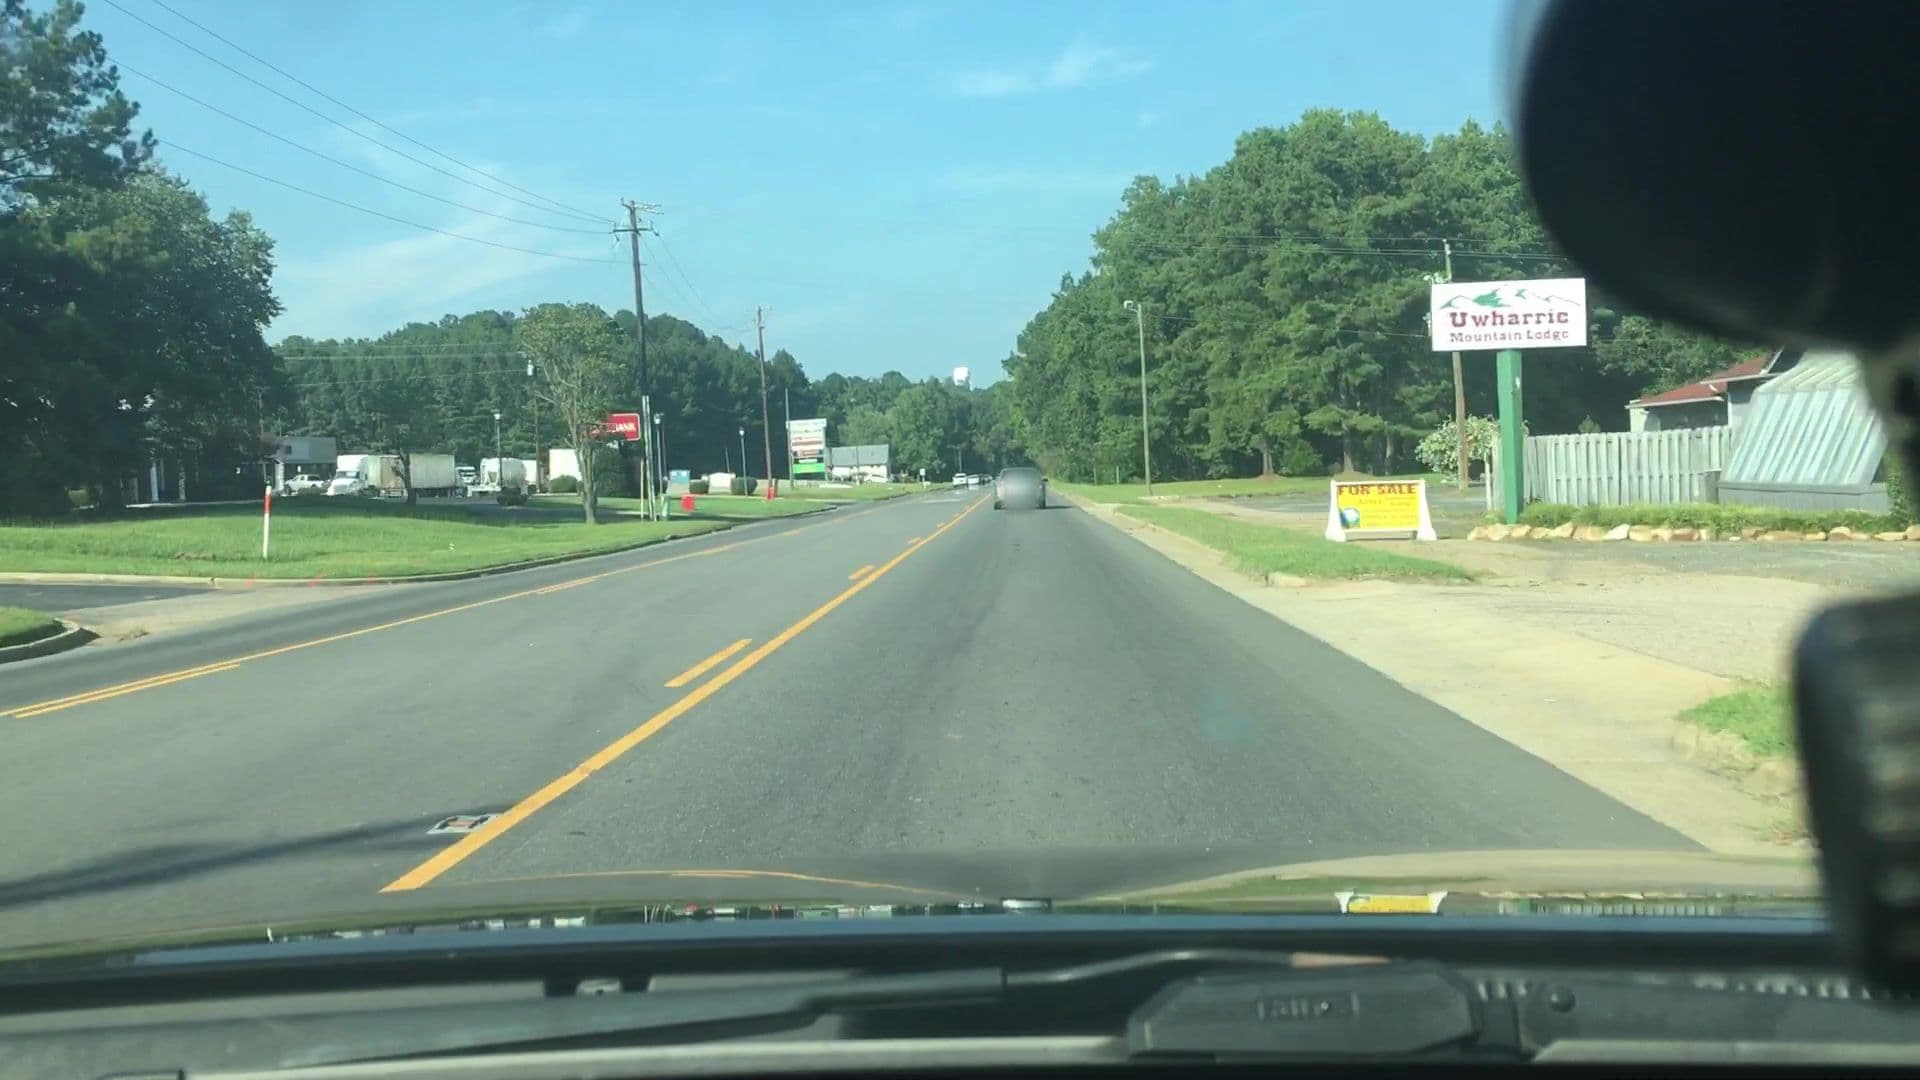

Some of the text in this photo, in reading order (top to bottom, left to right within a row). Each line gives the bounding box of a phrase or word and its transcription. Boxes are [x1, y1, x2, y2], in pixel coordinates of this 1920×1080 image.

[1449, 329, 1569, 342] Mountain Lodge
[1336, 484, 1417, 495] FOR SALE
